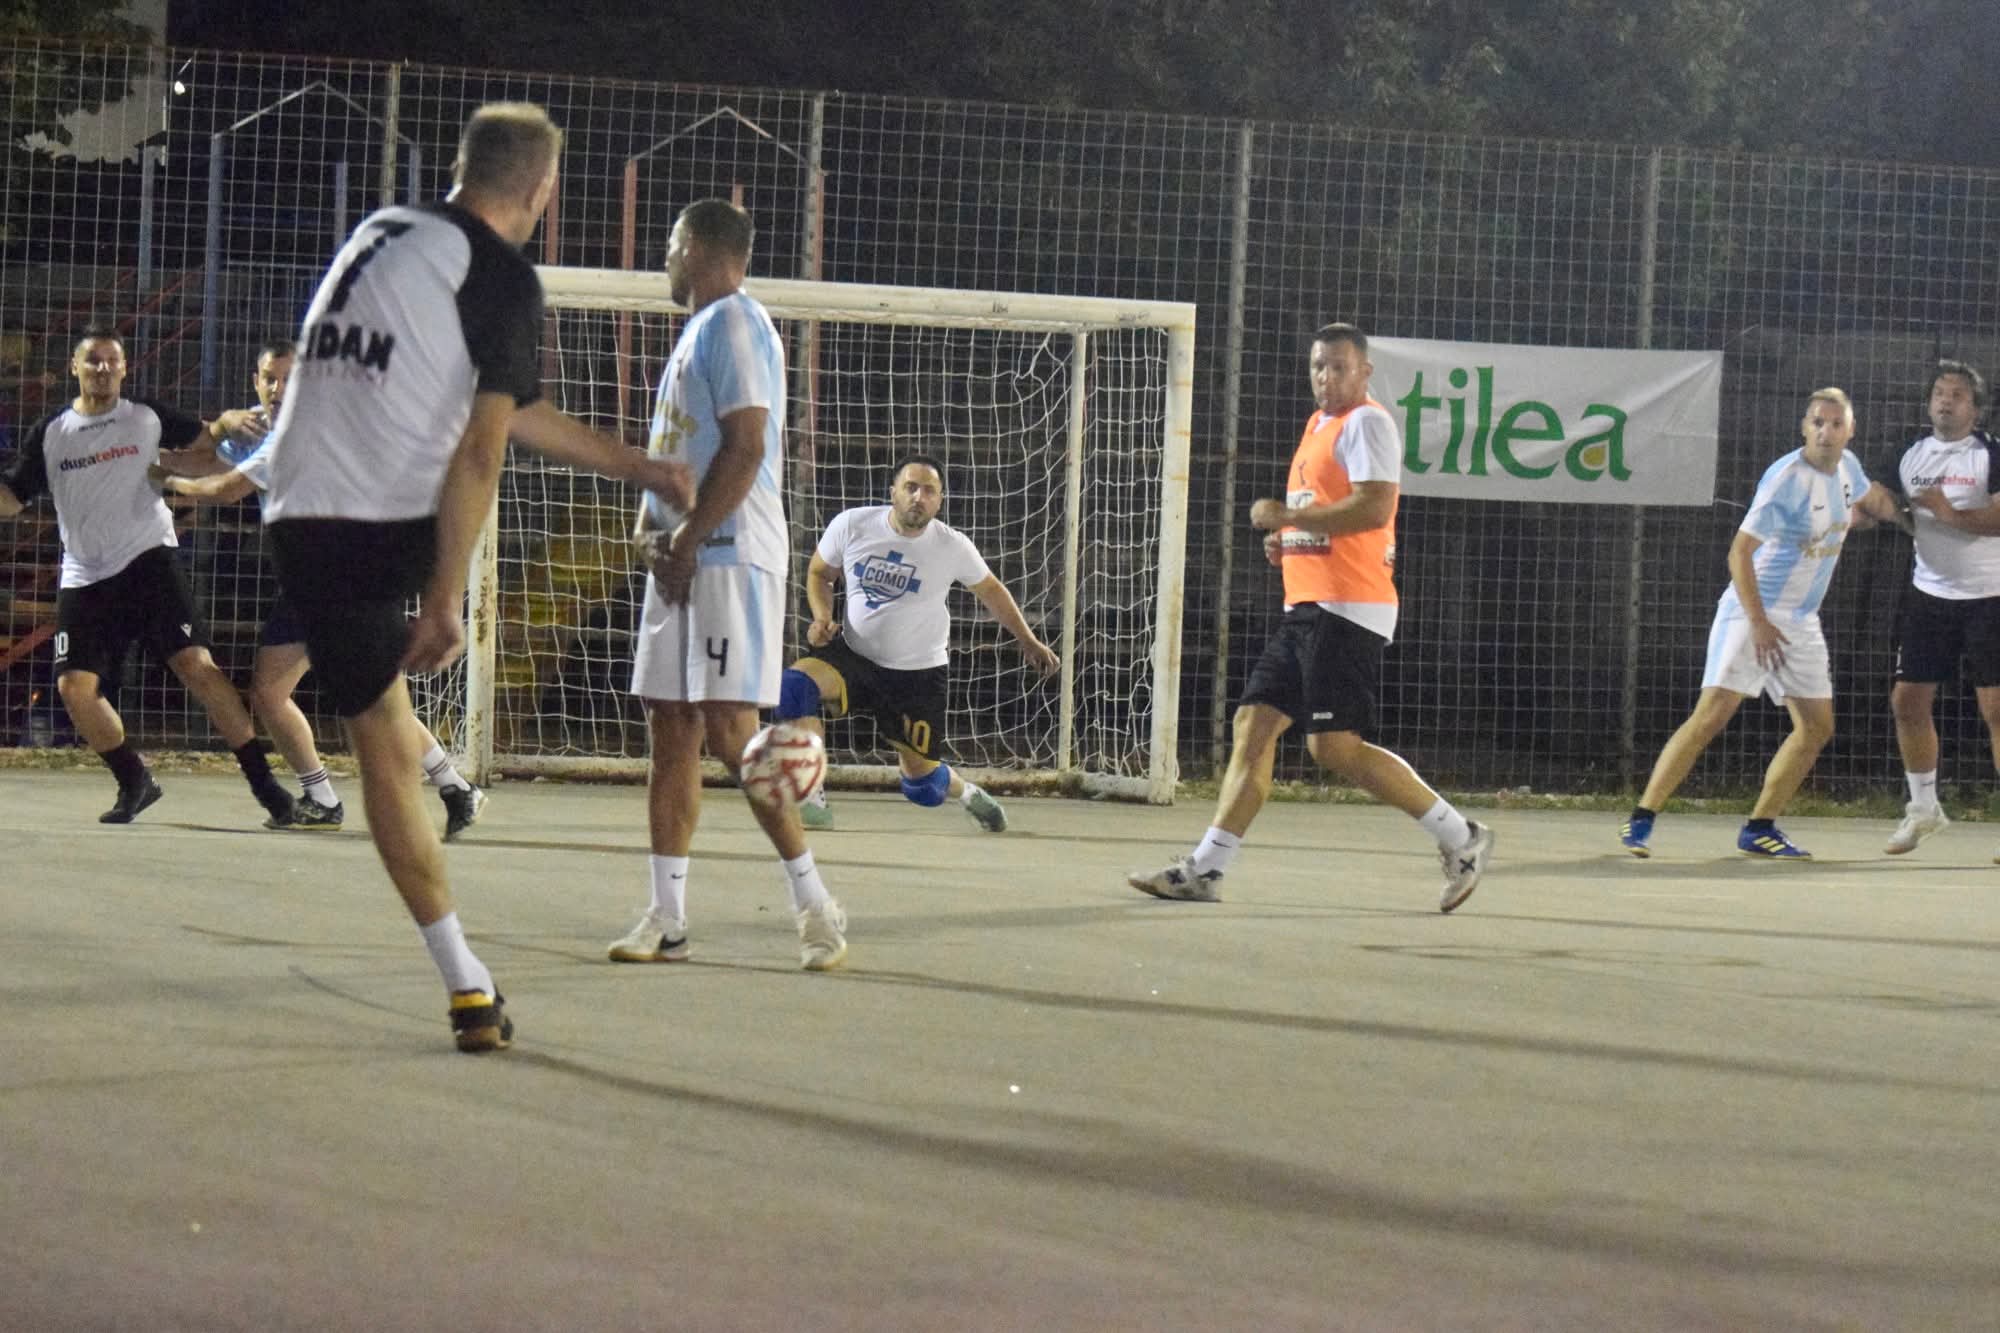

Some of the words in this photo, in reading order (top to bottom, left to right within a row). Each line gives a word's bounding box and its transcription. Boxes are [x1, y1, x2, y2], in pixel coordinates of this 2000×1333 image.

[326, 219, 415, 313] 7
[1396, 366, 1632, 482] tilea
[864, 566, 907, 590] COMO
[706, 636, 729, 677] 4
